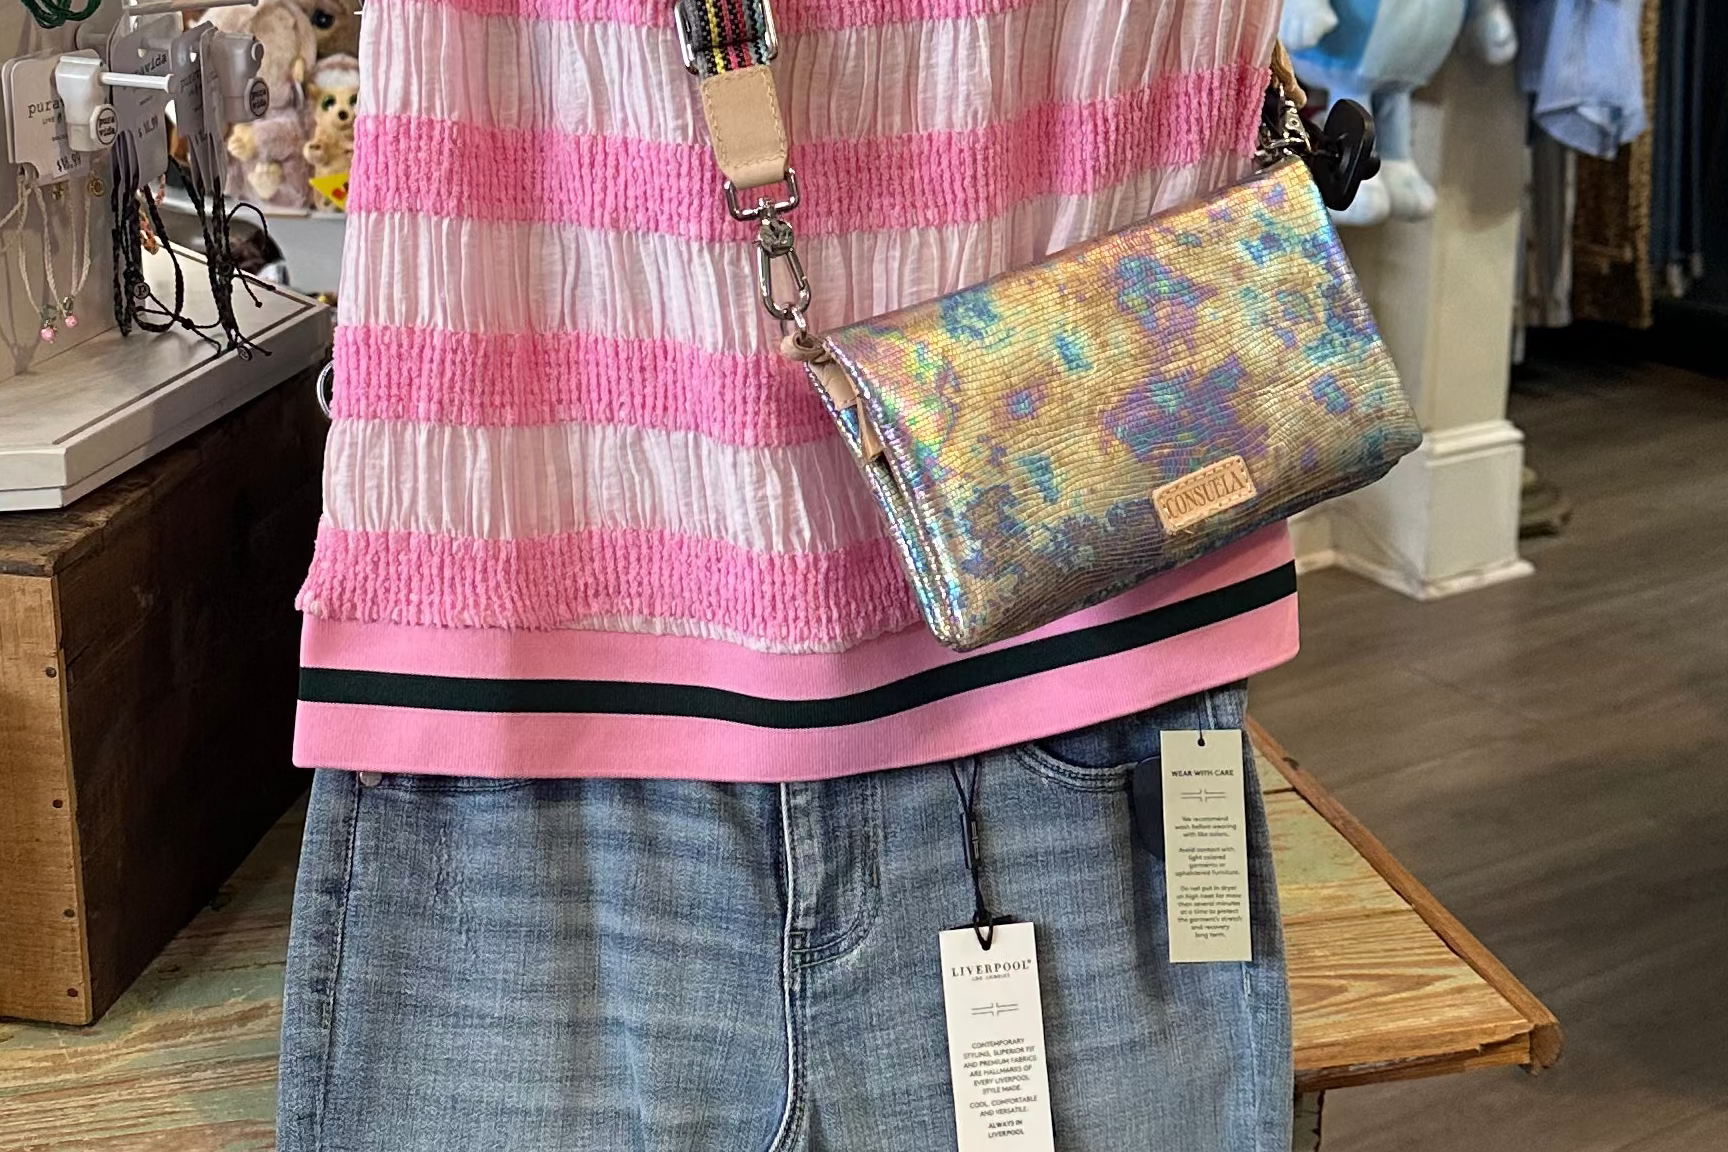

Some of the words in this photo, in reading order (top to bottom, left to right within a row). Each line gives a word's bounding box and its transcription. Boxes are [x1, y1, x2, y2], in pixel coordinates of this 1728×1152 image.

[99, 115, 114, 127] pura
[99, 126, 115, 137] vida
[1166, 472, 1246, 518] CONSUELA
[973, 1078, 994, 1087] EVERY
[988, 1119, 1015, 1129] ALWAYS
[988, 1128, 1024, 1139] LIVERPOOL
